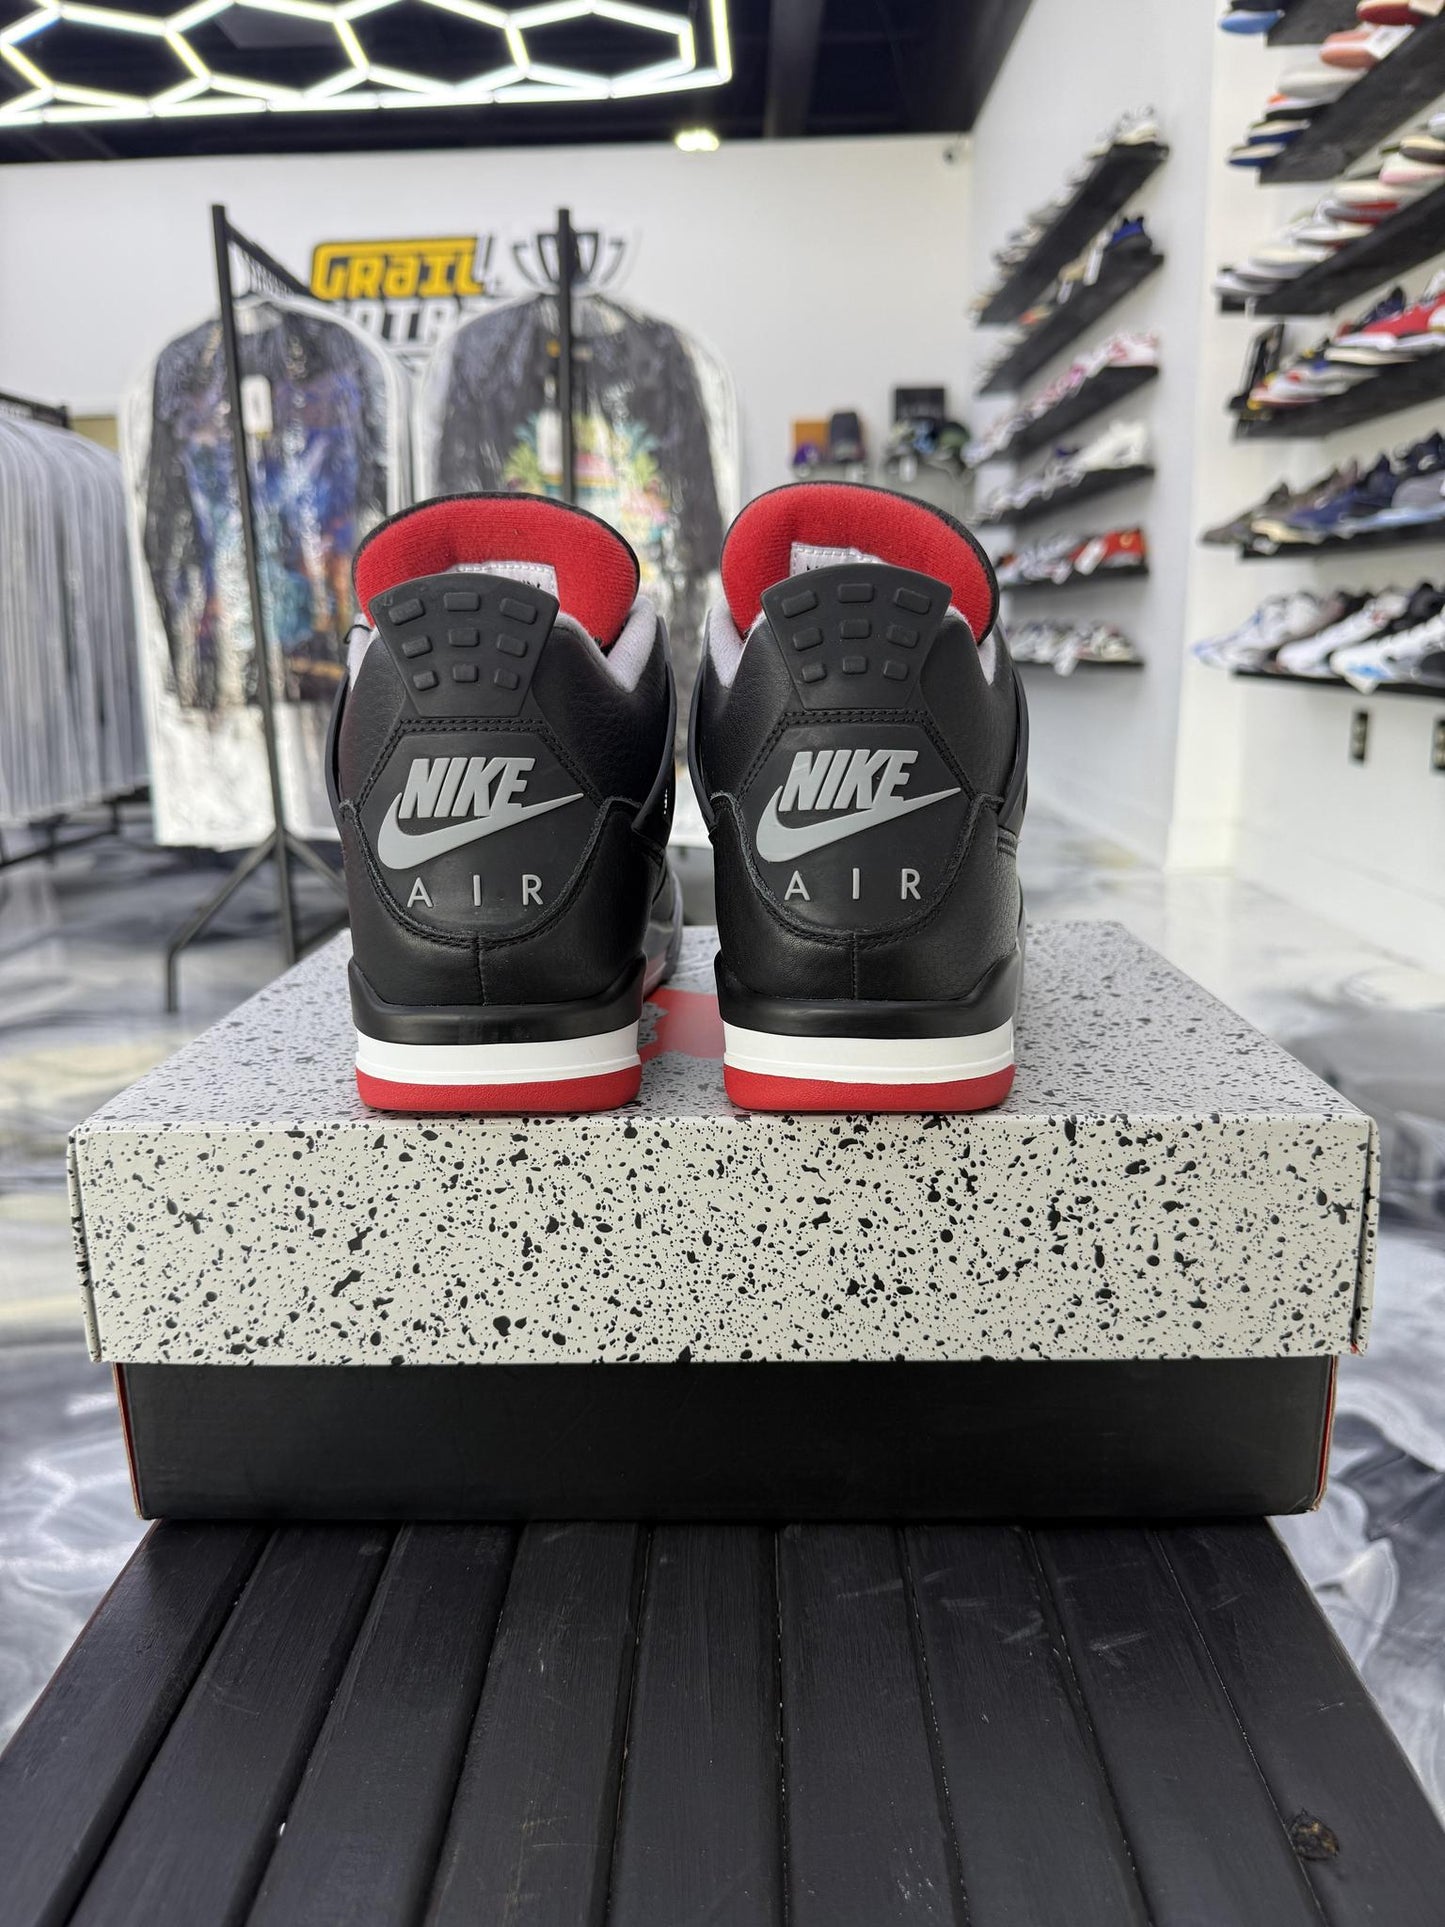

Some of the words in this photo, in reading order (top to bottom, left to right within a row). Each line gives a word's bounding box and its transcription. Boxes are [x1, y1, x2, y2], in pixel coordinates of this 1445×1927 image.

[398, 757, 536, 819] NIKE
[779, 749, 918, 812] NIKE
[407, 874, 544, 908] AIR
[784, 867, 922, 901] AIR
